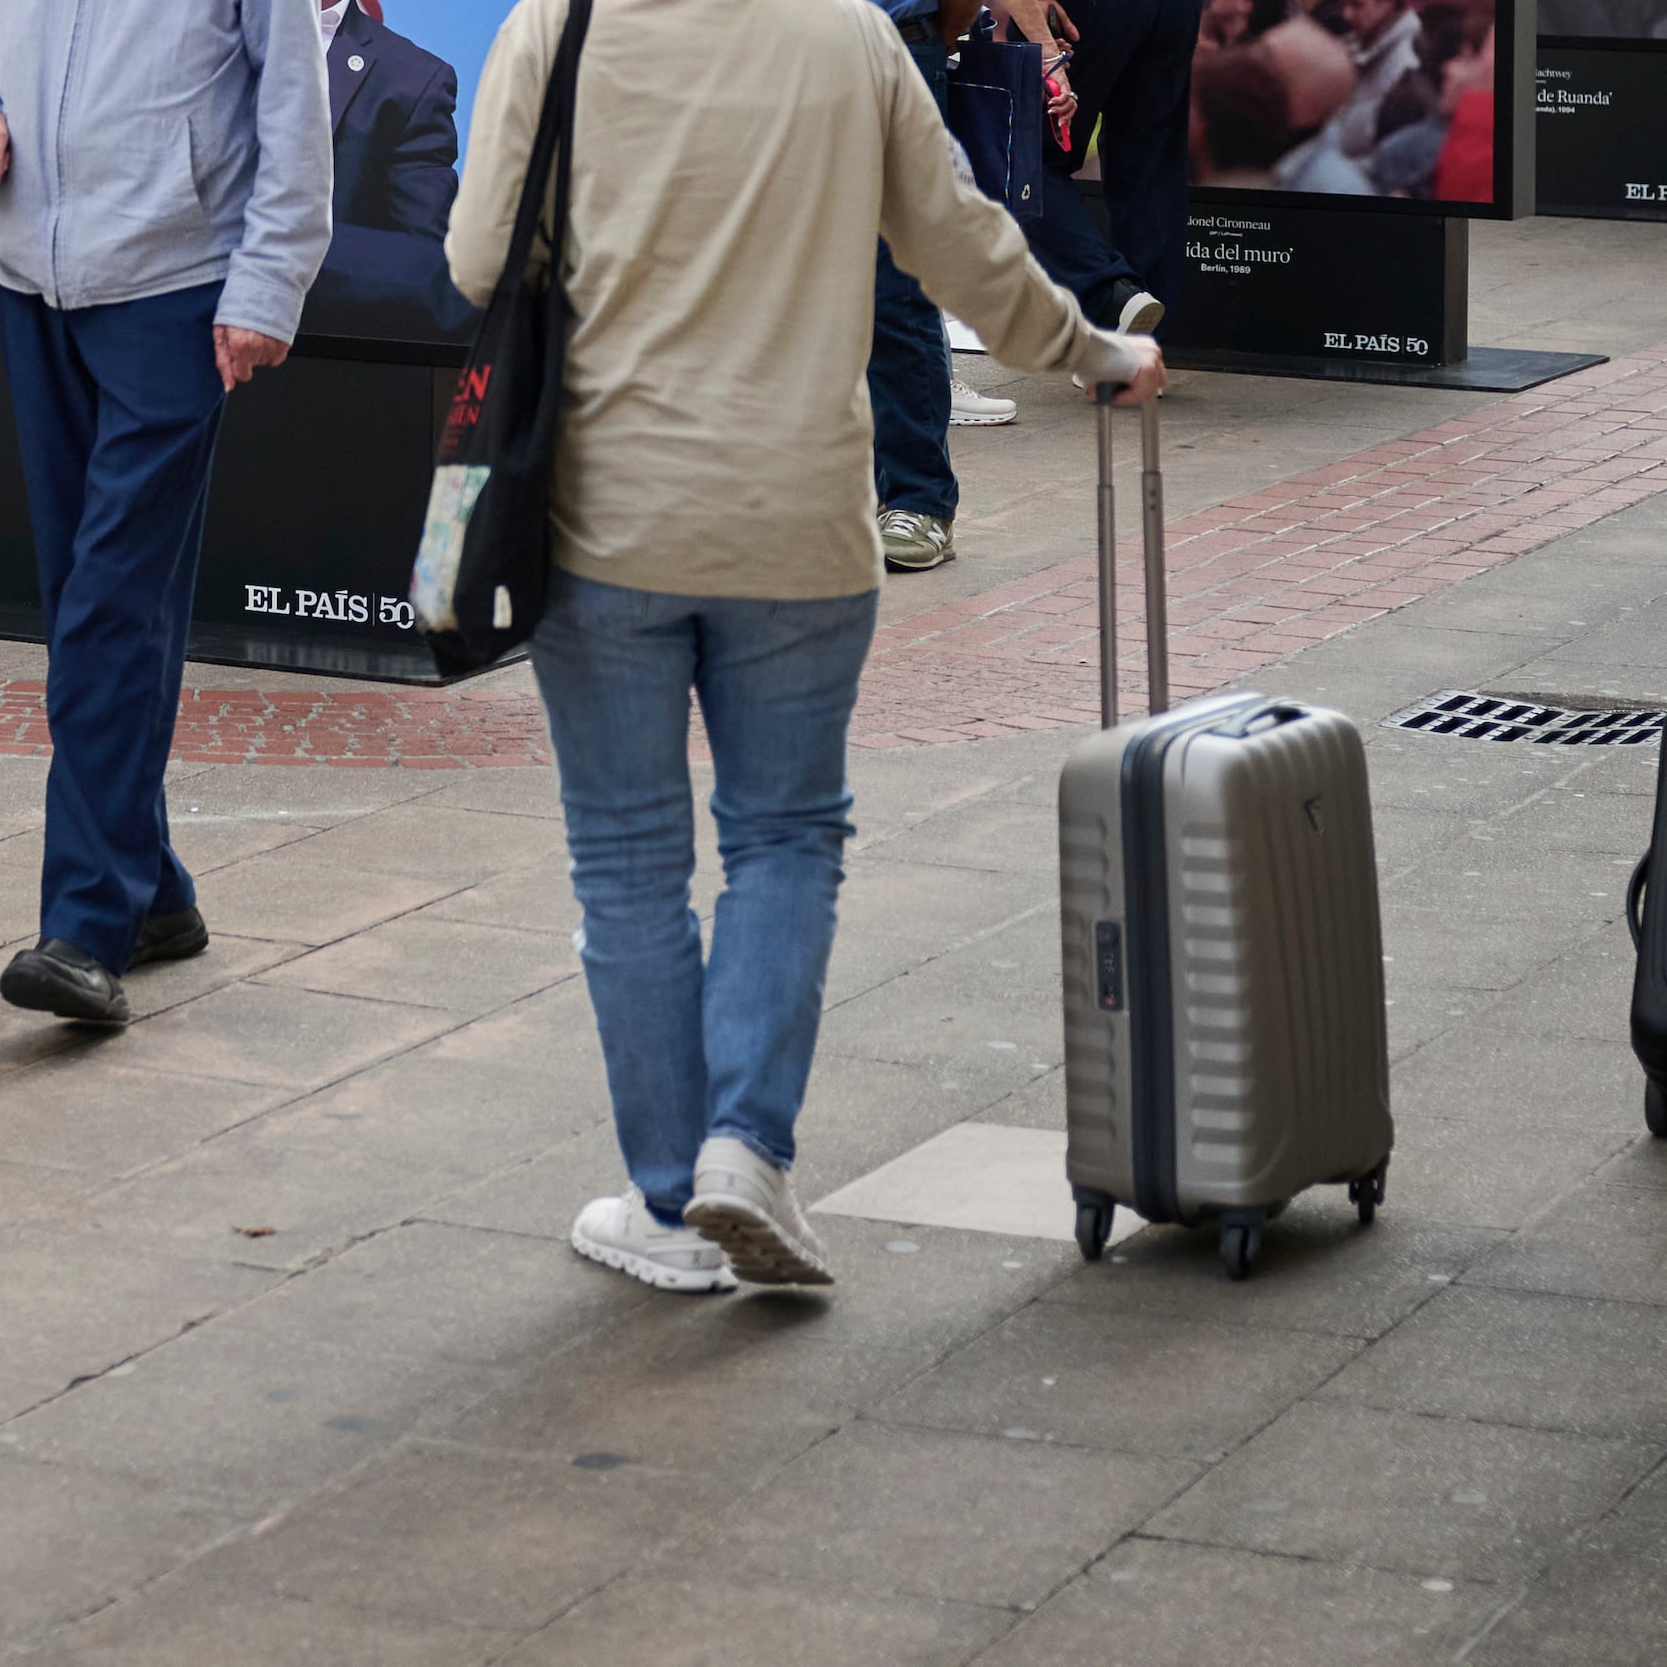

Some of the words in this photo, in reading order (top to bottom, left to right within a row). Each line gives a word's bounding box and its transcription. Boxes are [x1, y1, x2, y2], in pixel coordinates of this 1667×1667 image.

[1537, 88, 1555, 103] de
[1557, 89, 1613, 106] Ruanda'
[1625, 182, 1656, 201] EL
[1187, 215, 1215, 228] ionel
[1216, 216, 1271, 231] Cironneau
[1214, 243, 1240, 261] del
[1244, 247, 1294, 264] muro'
[1230, 264, 1251, 274] 1989
[1323, 332, 1353, 350] EL
[1354, 333, 1401, 353] PAÍS
[1405, 337, 1429, 356] 50
[244, 584, 291, 615] EL
[294, 589, 369, 623] PAÍS
[378, 596, 416, 630] 50
